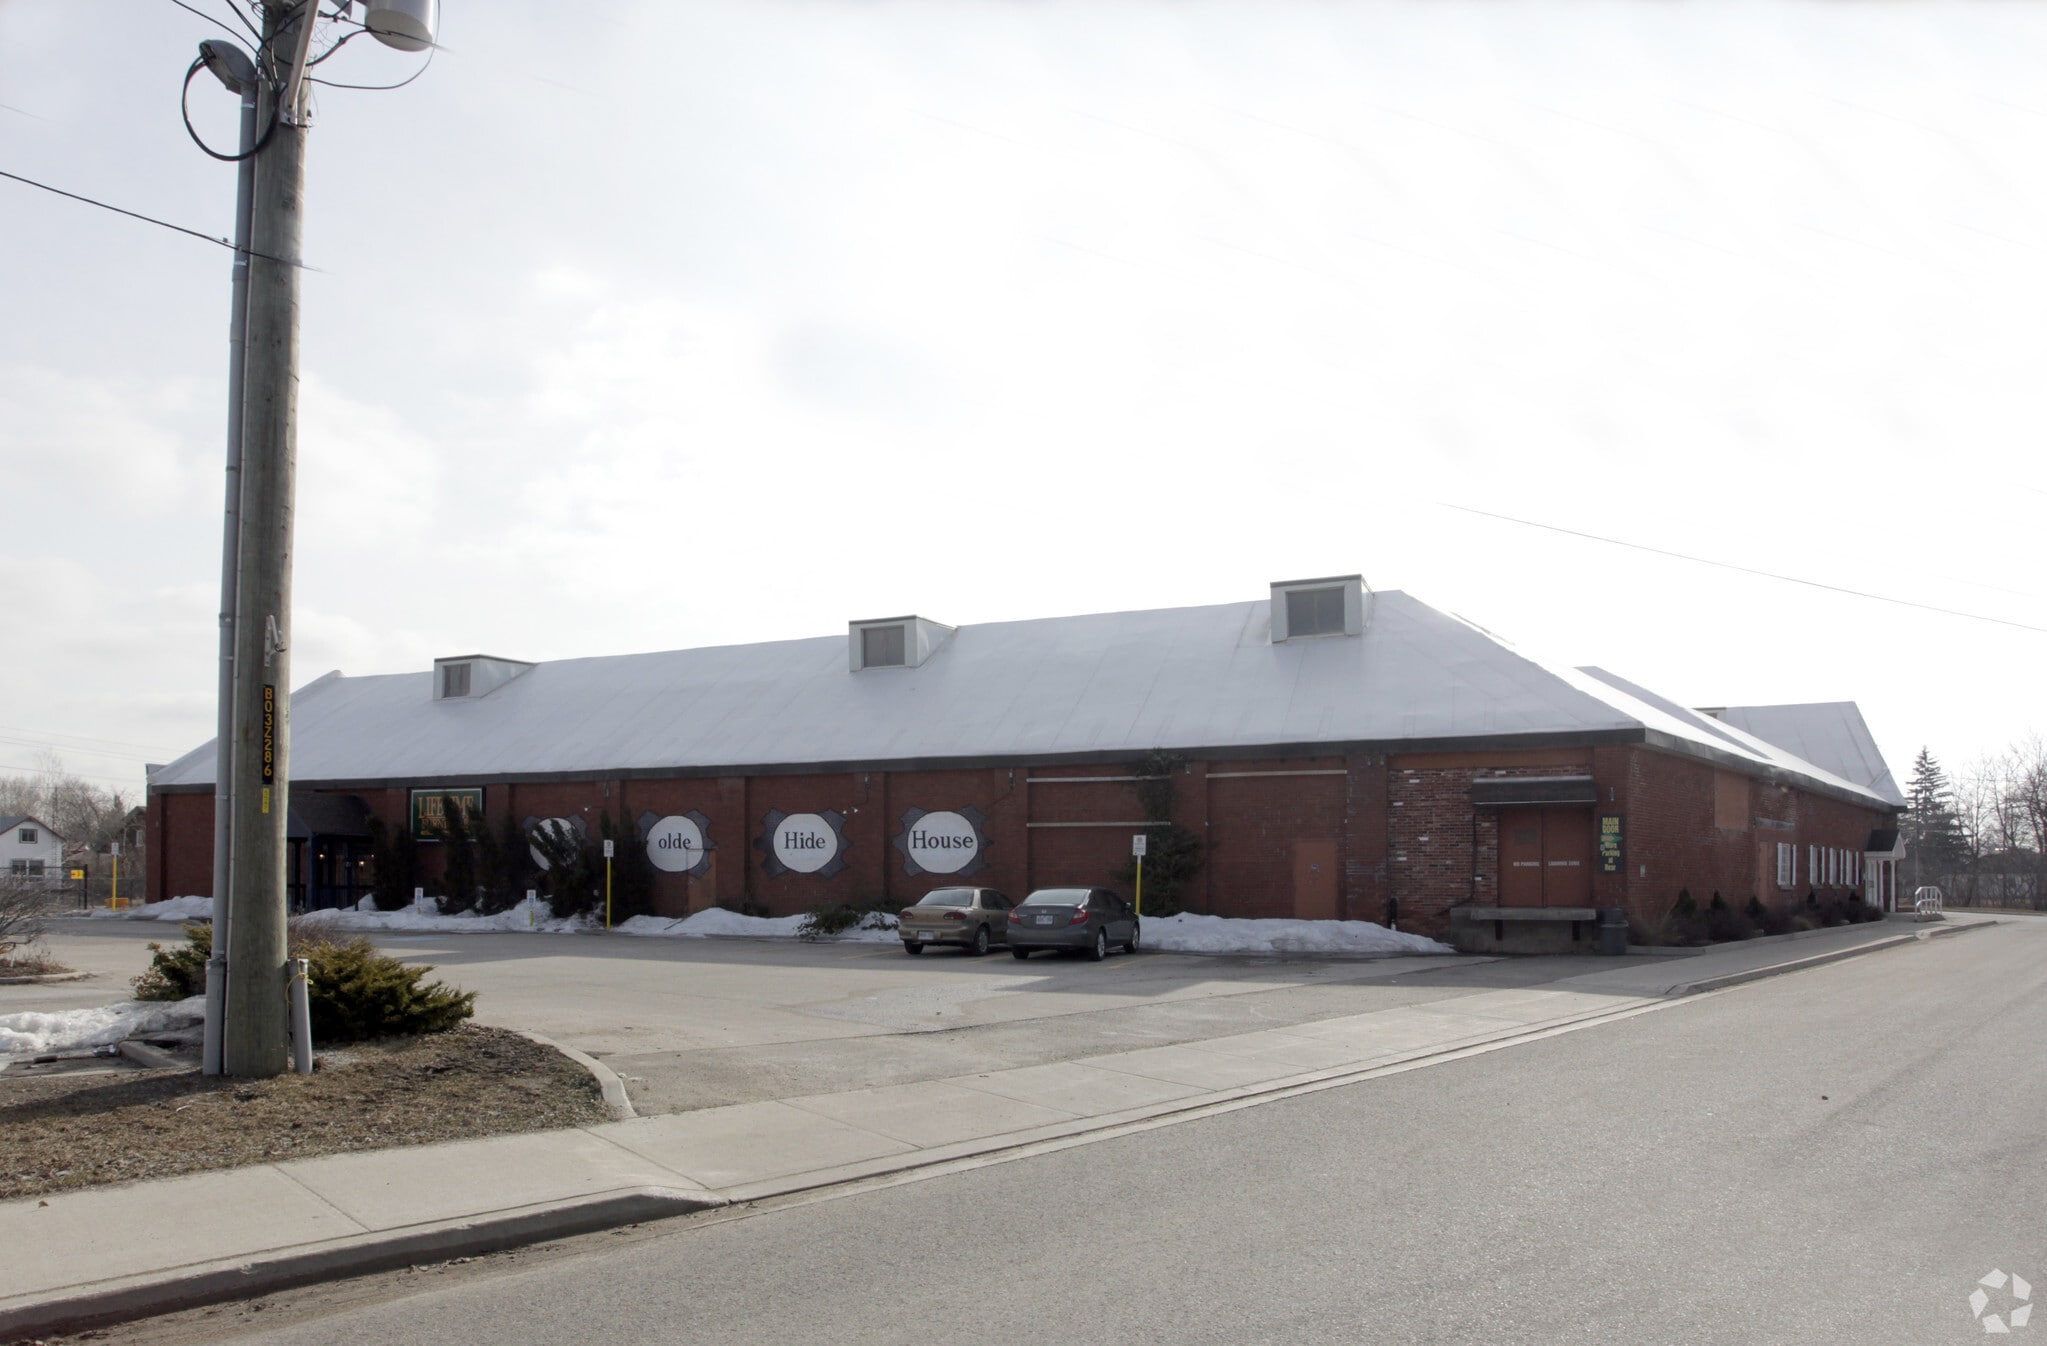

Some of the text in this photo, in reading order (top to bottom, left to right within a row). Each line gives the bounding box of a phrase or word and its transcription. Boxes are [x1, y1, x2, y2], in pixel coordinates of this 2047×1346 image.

[1602, 817, 1619, 825] MAIN
[1602, 825, 1619, 833] DOOR
[658, 830, 974, 850] olde Hide House
